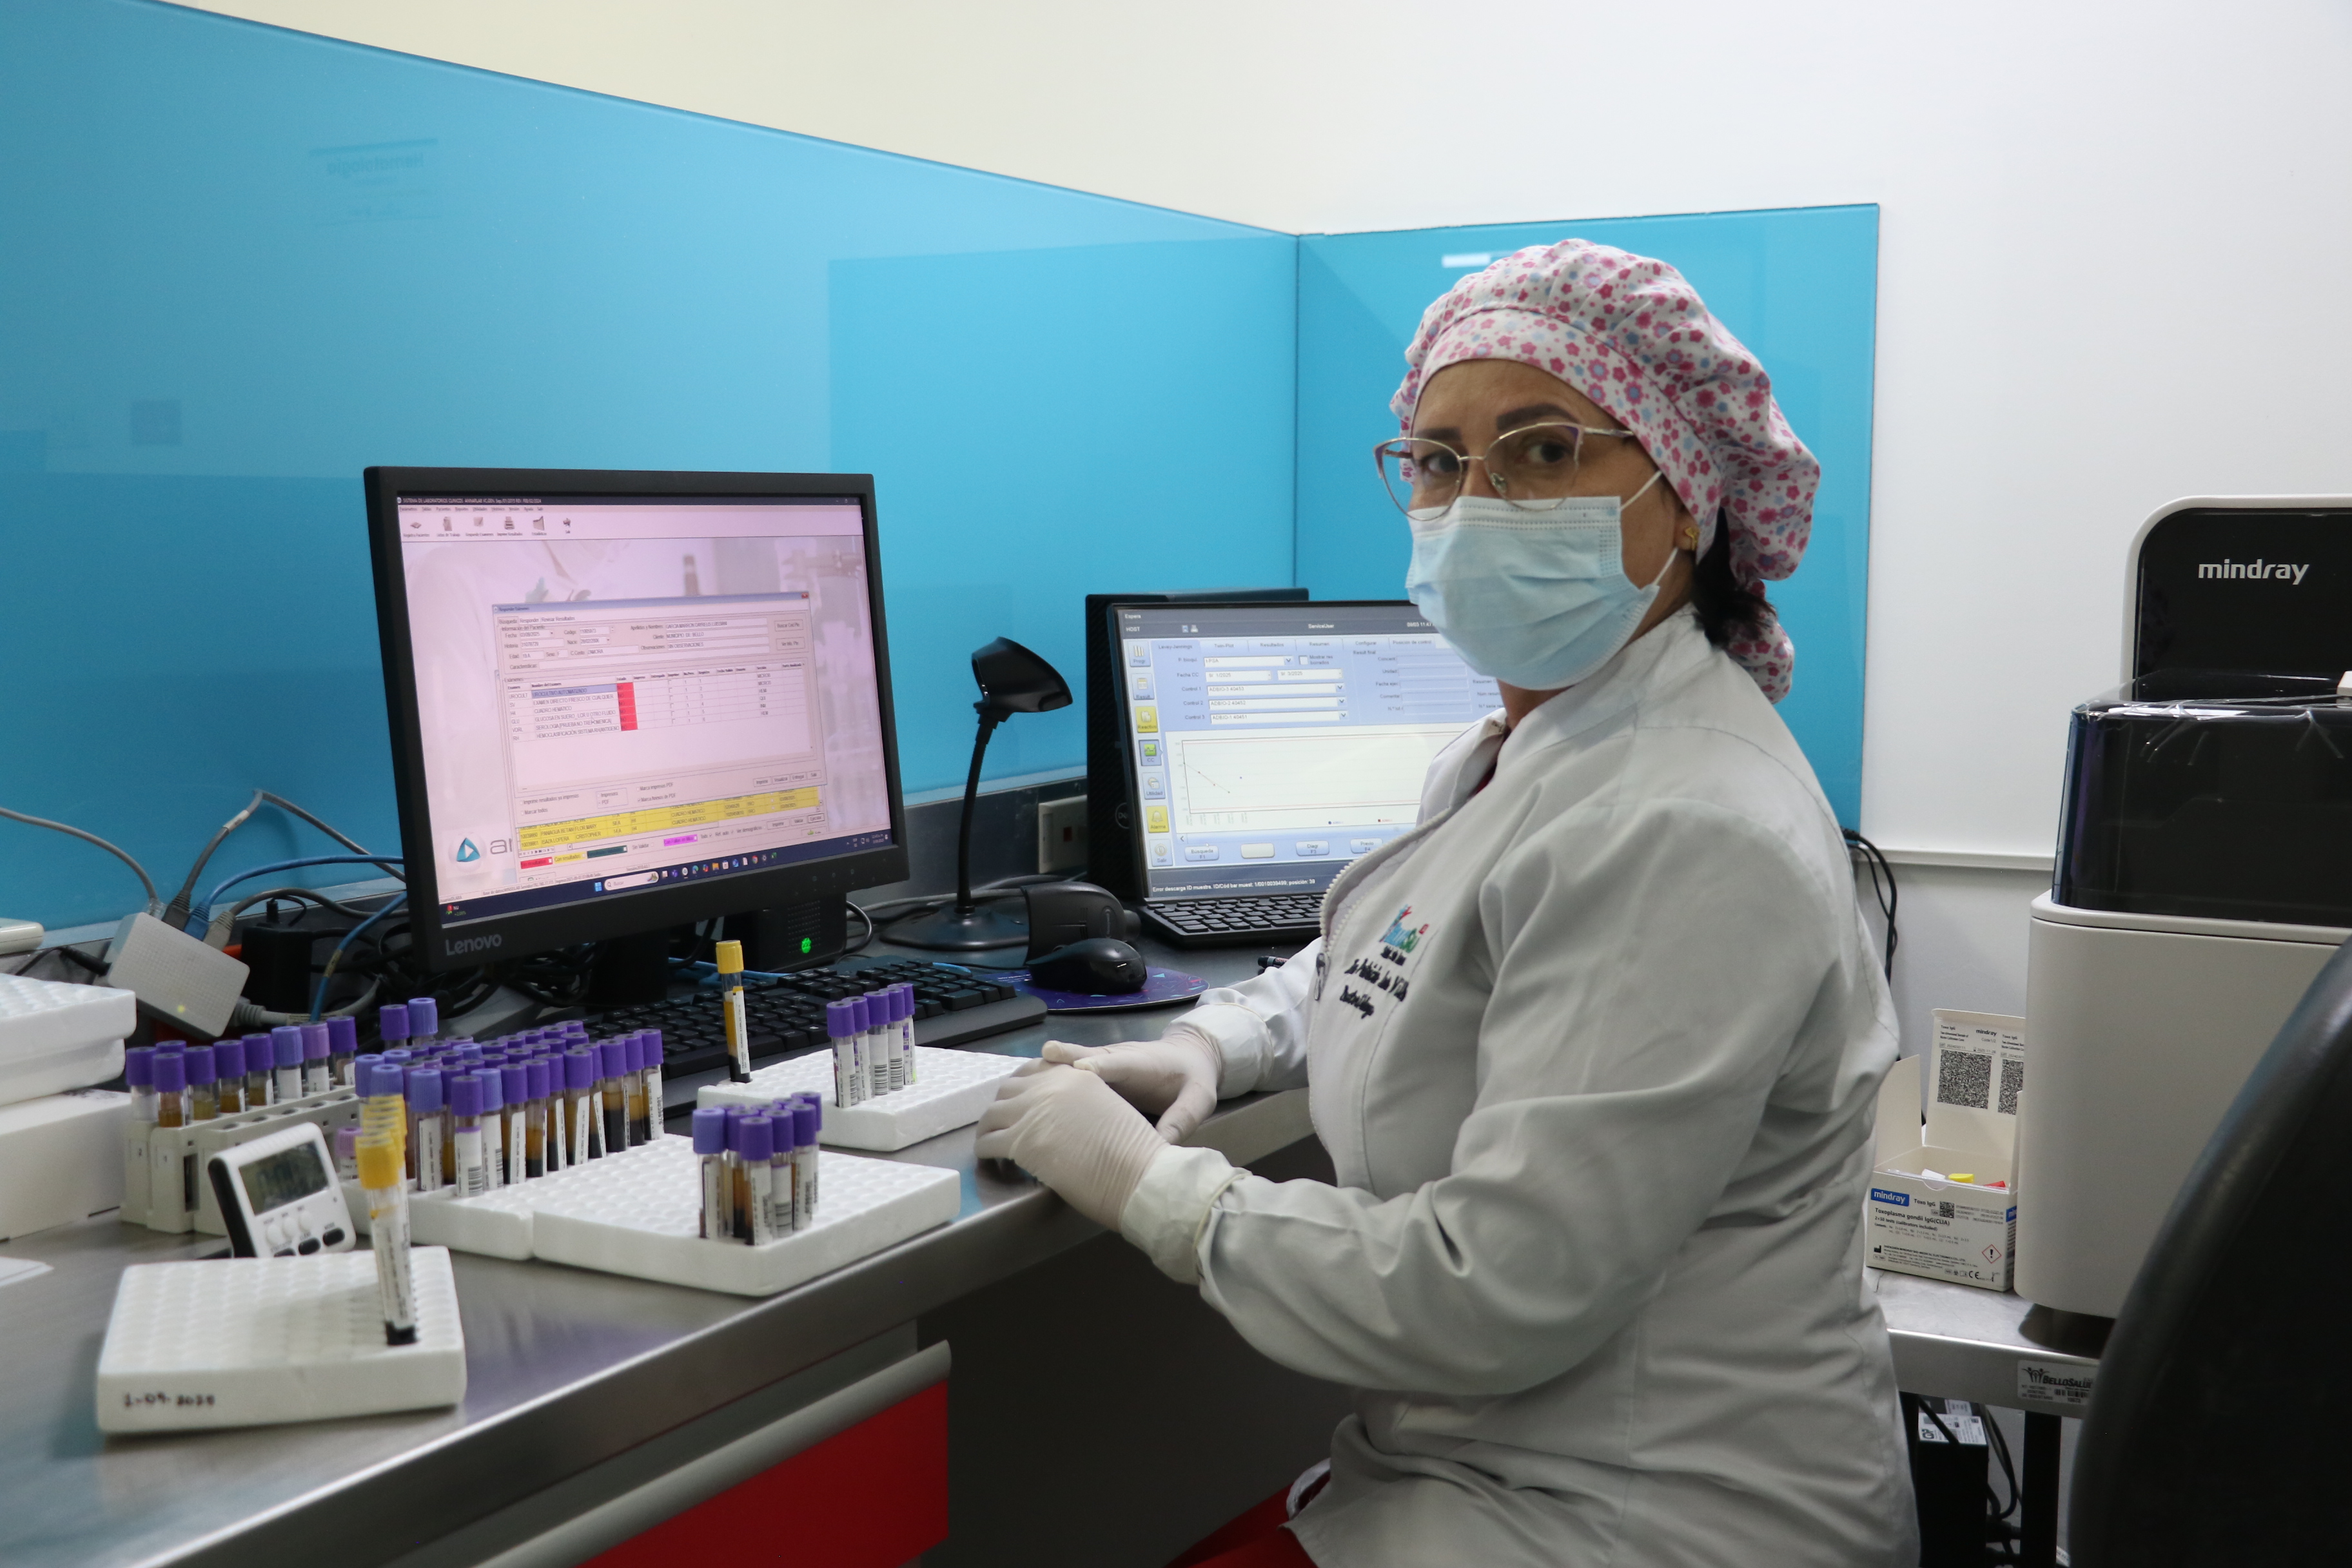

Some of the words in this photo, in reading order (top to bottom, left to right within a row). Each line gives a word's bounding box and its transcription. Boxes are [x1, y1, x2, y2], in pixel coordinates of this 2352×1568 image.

[2199, 559, 2309, 585] mindray
[446, 934, 502, 956] Lenovo
[1874, 1190, 1905, 1205] mindray
[1875, 1208, 1905, 1218] Toxoplasma
[1906, 1213, 1923, 1222] gondii
[1925, 1217, 1950, 1226] IgG(CLIA)
